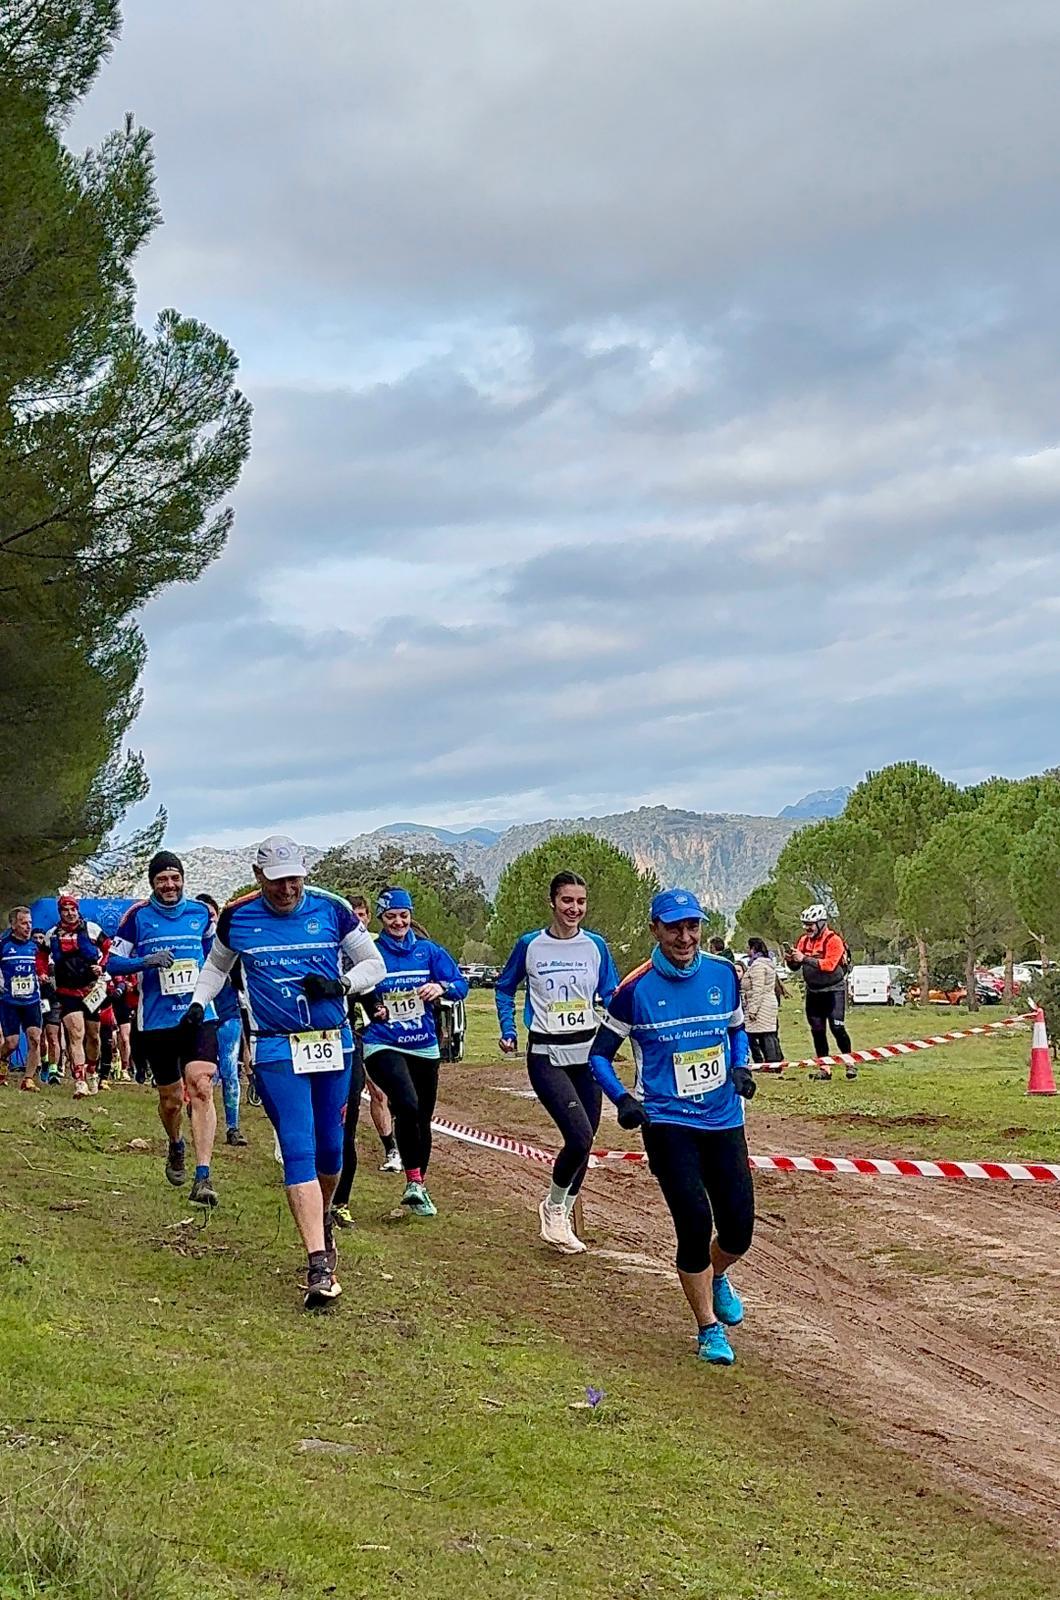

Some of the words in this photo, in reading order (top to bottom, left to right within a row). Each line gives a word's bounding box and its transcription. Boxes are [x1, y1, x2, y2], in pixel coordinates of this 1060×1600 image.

[168, 970, 193, 984] 117
[392, 998, 416, 1013] 116
[557, 1011, 586, 1027] 164
[397, 1032, 429, 1043] RONDA
[658, 1033, 674, 1043] Club
[681, 1028, 714, 1038] Atletismo
[302, 1043, 335, 1060] 136
[687, 1059, 720, 1082] 130
